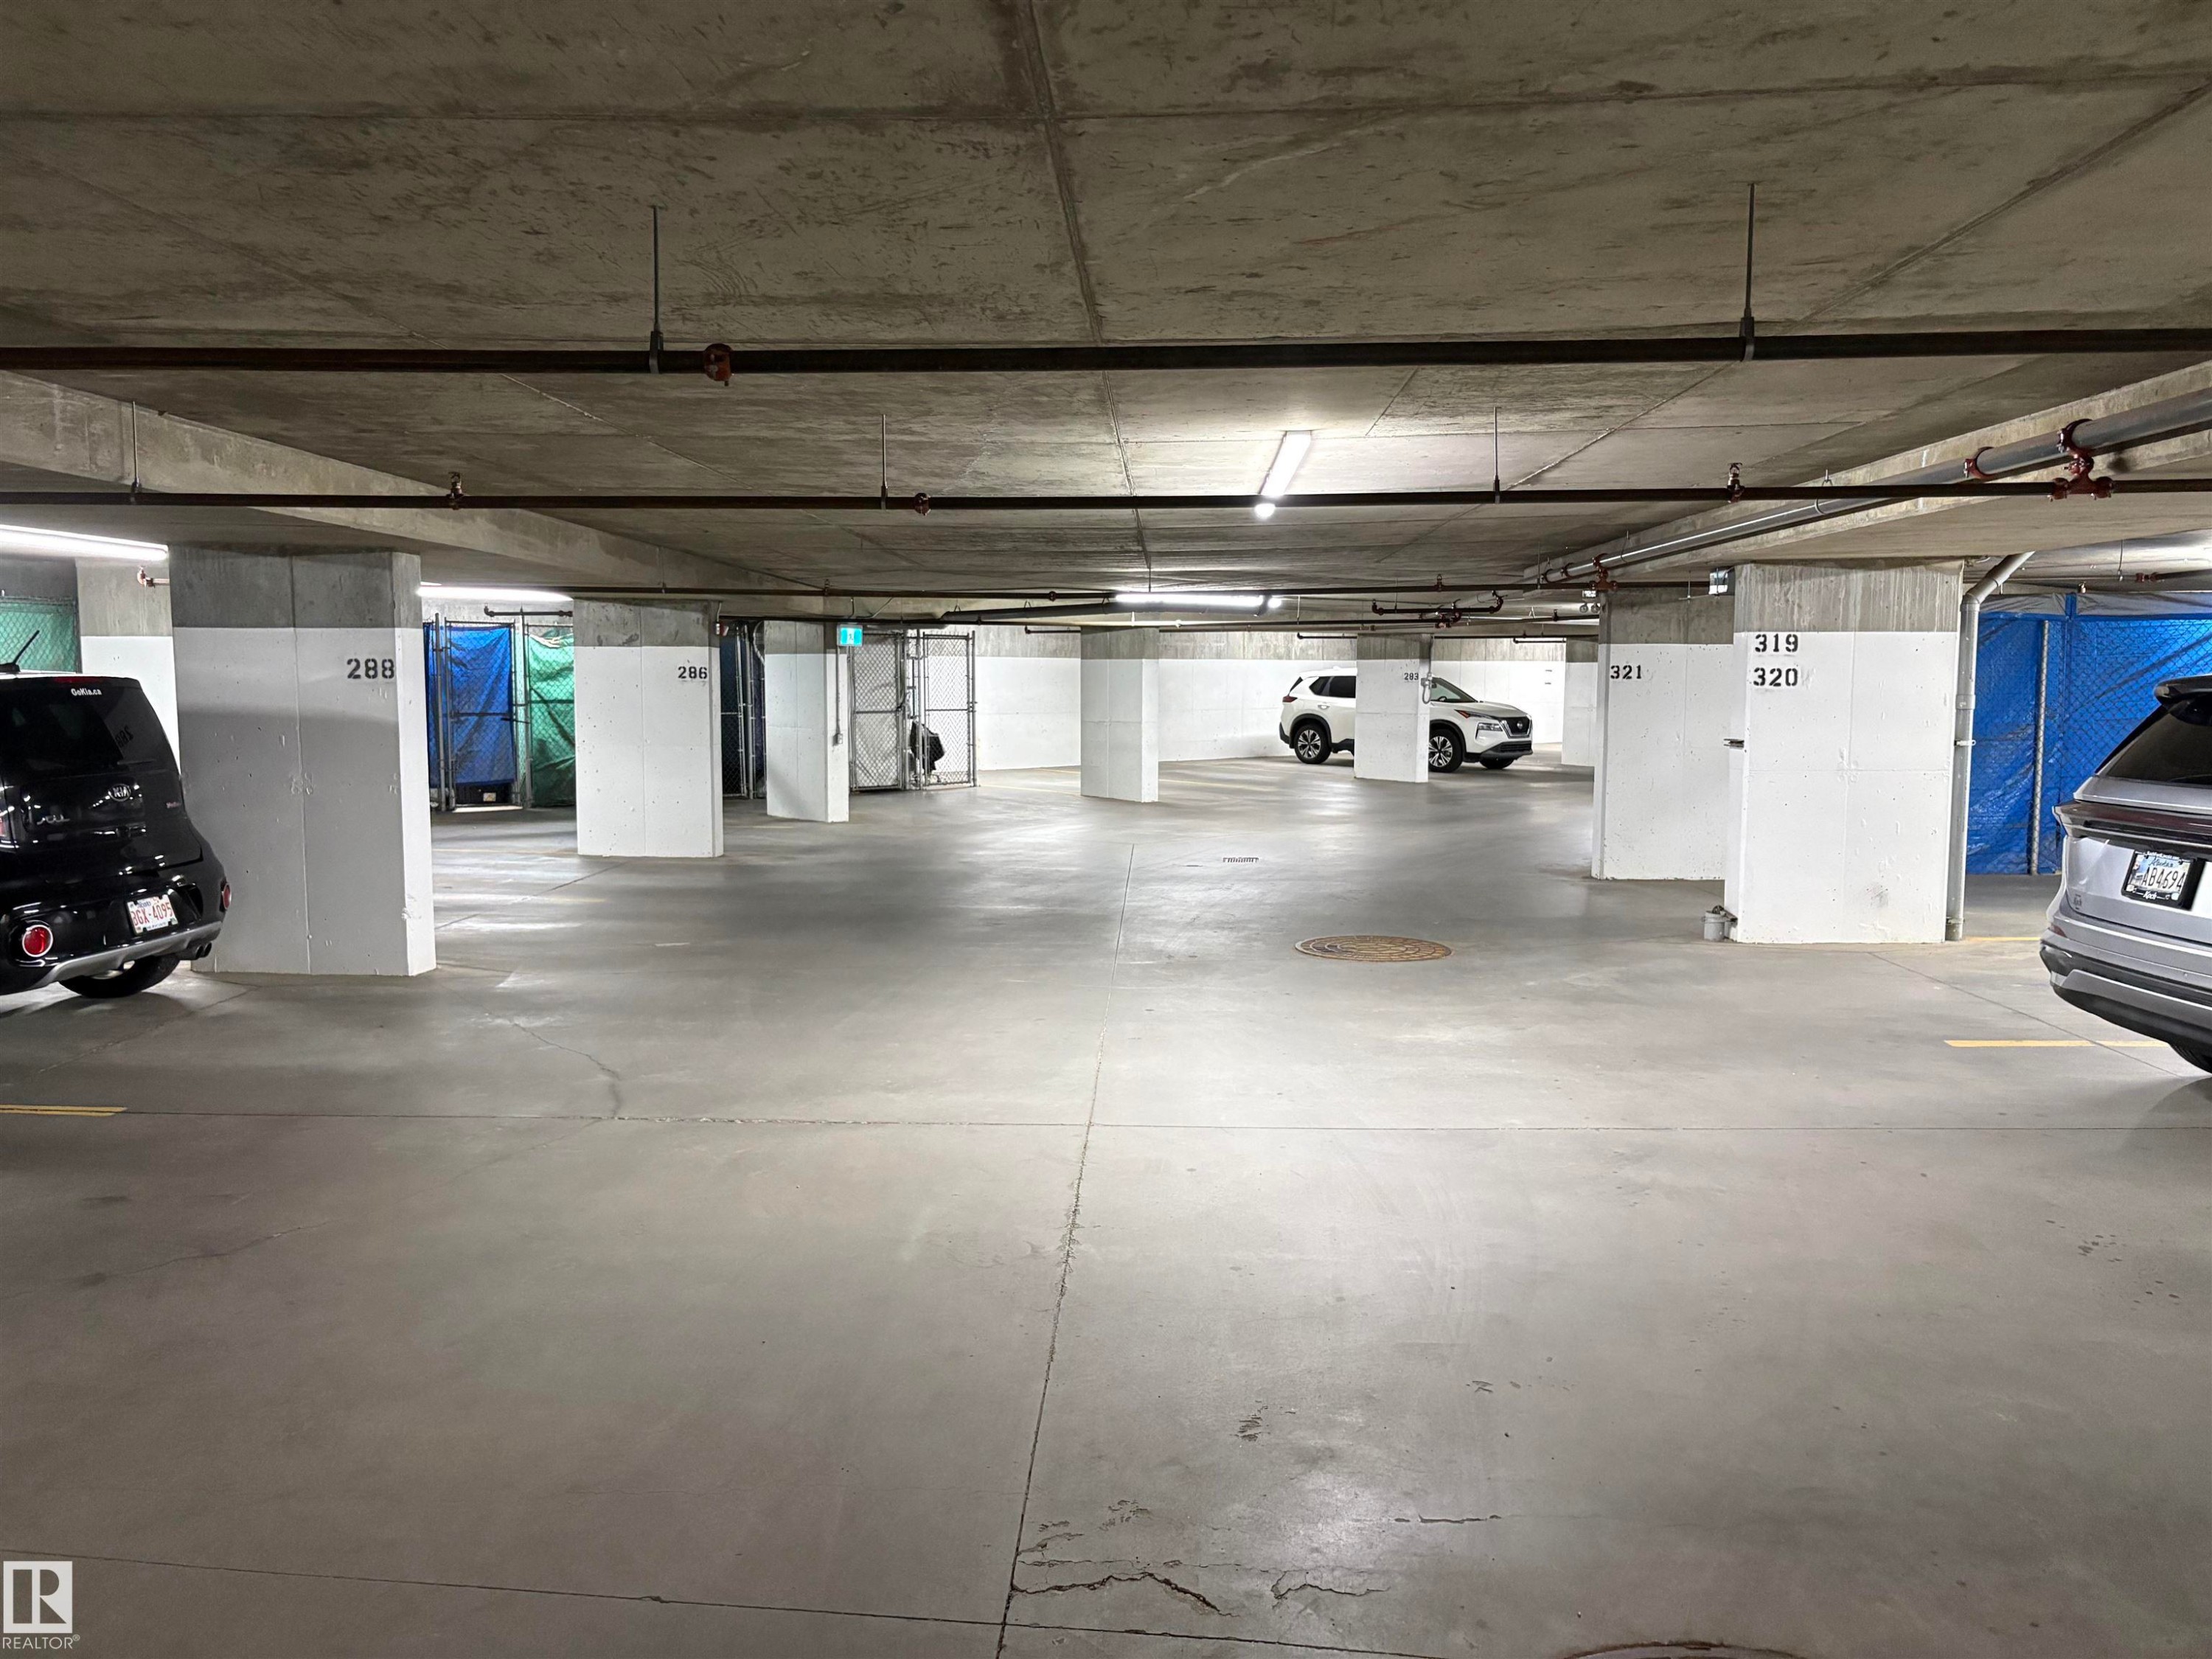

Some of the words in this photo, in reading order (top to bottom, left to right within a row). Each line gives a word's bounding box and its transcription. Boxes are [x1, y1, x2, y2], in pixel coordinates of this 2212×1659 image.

[1755, 633, 1798, 653] 319
[347, 658, 394, 679] 288
[678, 666, 708, 679] 286
[1610, 664, 1641, 679] 321
[1753, 667, 1798, 686] 320
